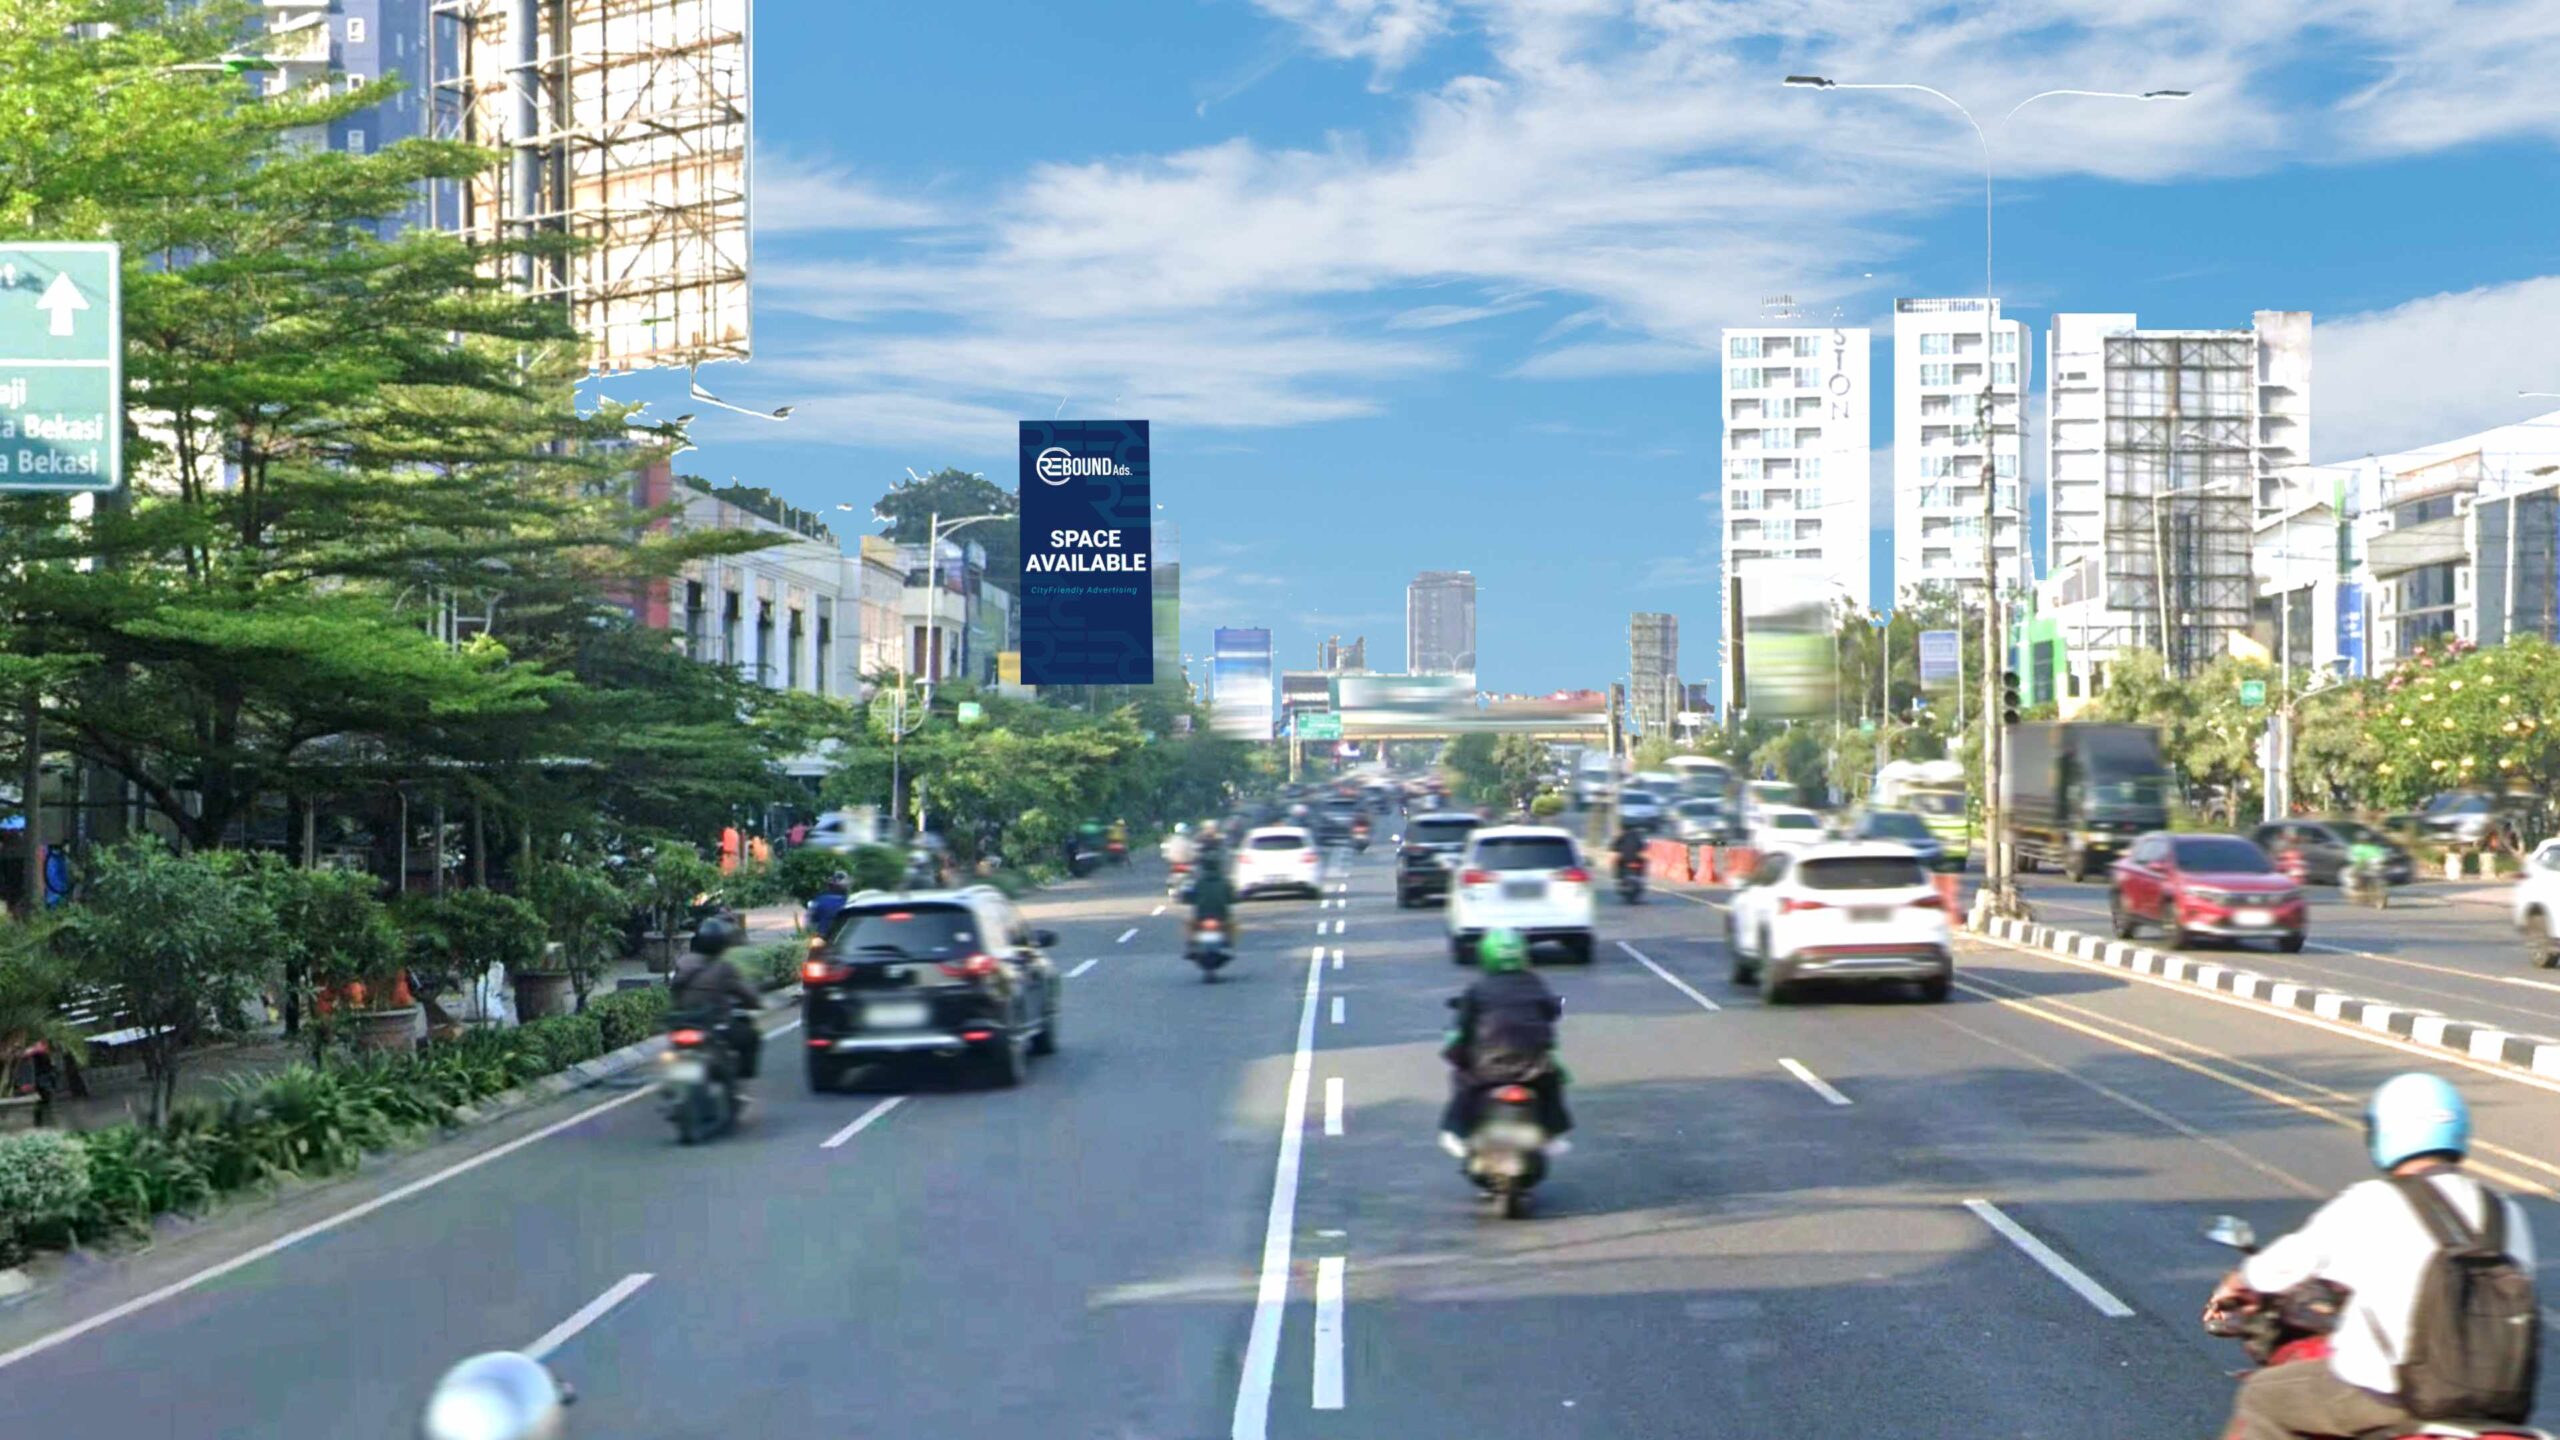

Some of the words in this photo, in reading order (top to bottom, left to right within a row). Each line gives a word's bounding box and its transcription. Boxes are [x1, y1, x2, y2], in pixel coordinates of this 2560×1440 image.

[24, 413, 104, 440] Bekasi
[18, 448, 98, 475] Bekasi
[1050, 529, 1122, 548] SPACE
[1025, 553, 1147, 572] AVAILABLE
[1086, 586, 1138, 595] Advertising
